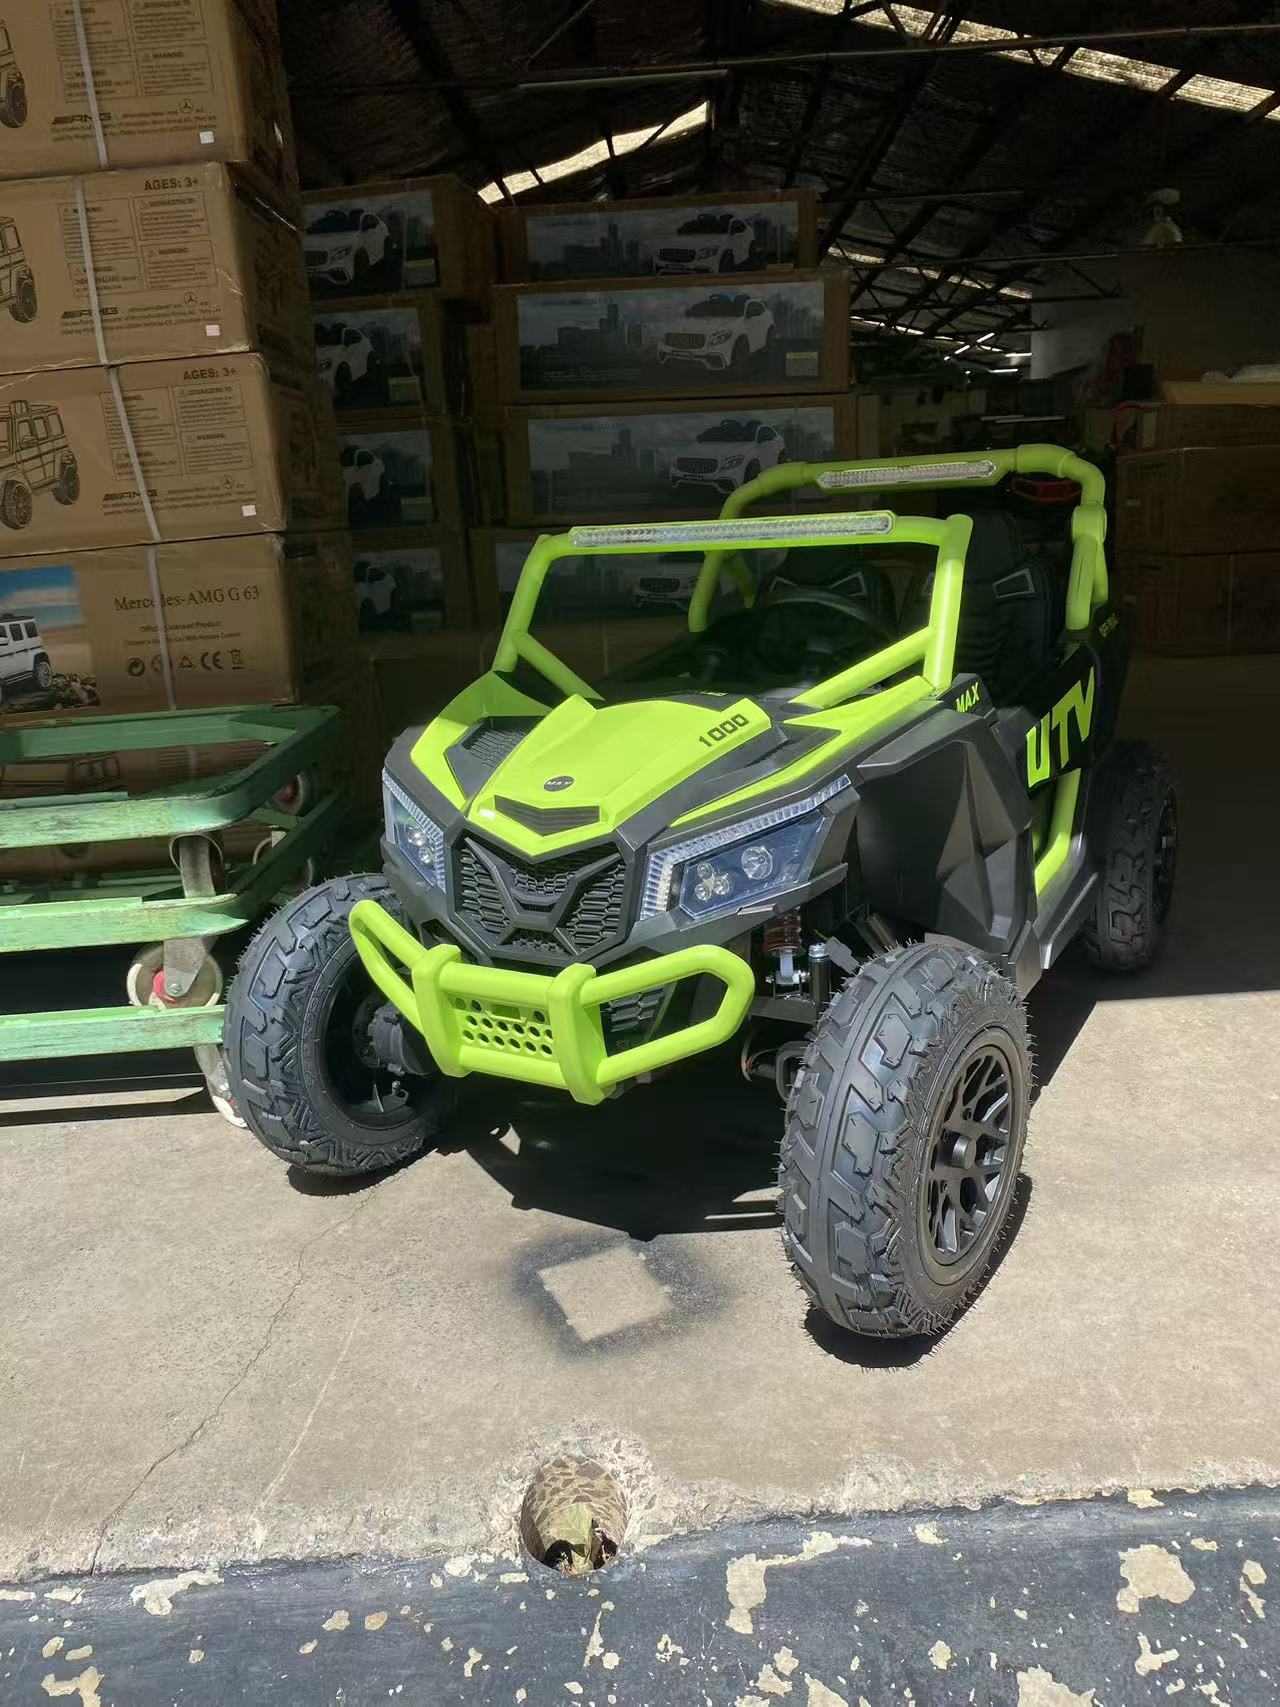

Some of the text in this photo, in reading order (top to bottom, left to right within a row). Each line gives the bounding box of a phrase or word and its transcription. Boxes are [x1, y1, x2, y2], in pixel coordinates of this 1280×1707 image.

[144, 176, 199, 191] AGES: 3+
[184, 368, 220, 381] AGES:
[228, 587, 240, 601] G
[243, 585, 259, 600] 63
[955, 681, 980, 713] MAX
[698, 713, 750, 747] 1000
[1025, 665, 1095, 788] UTV
